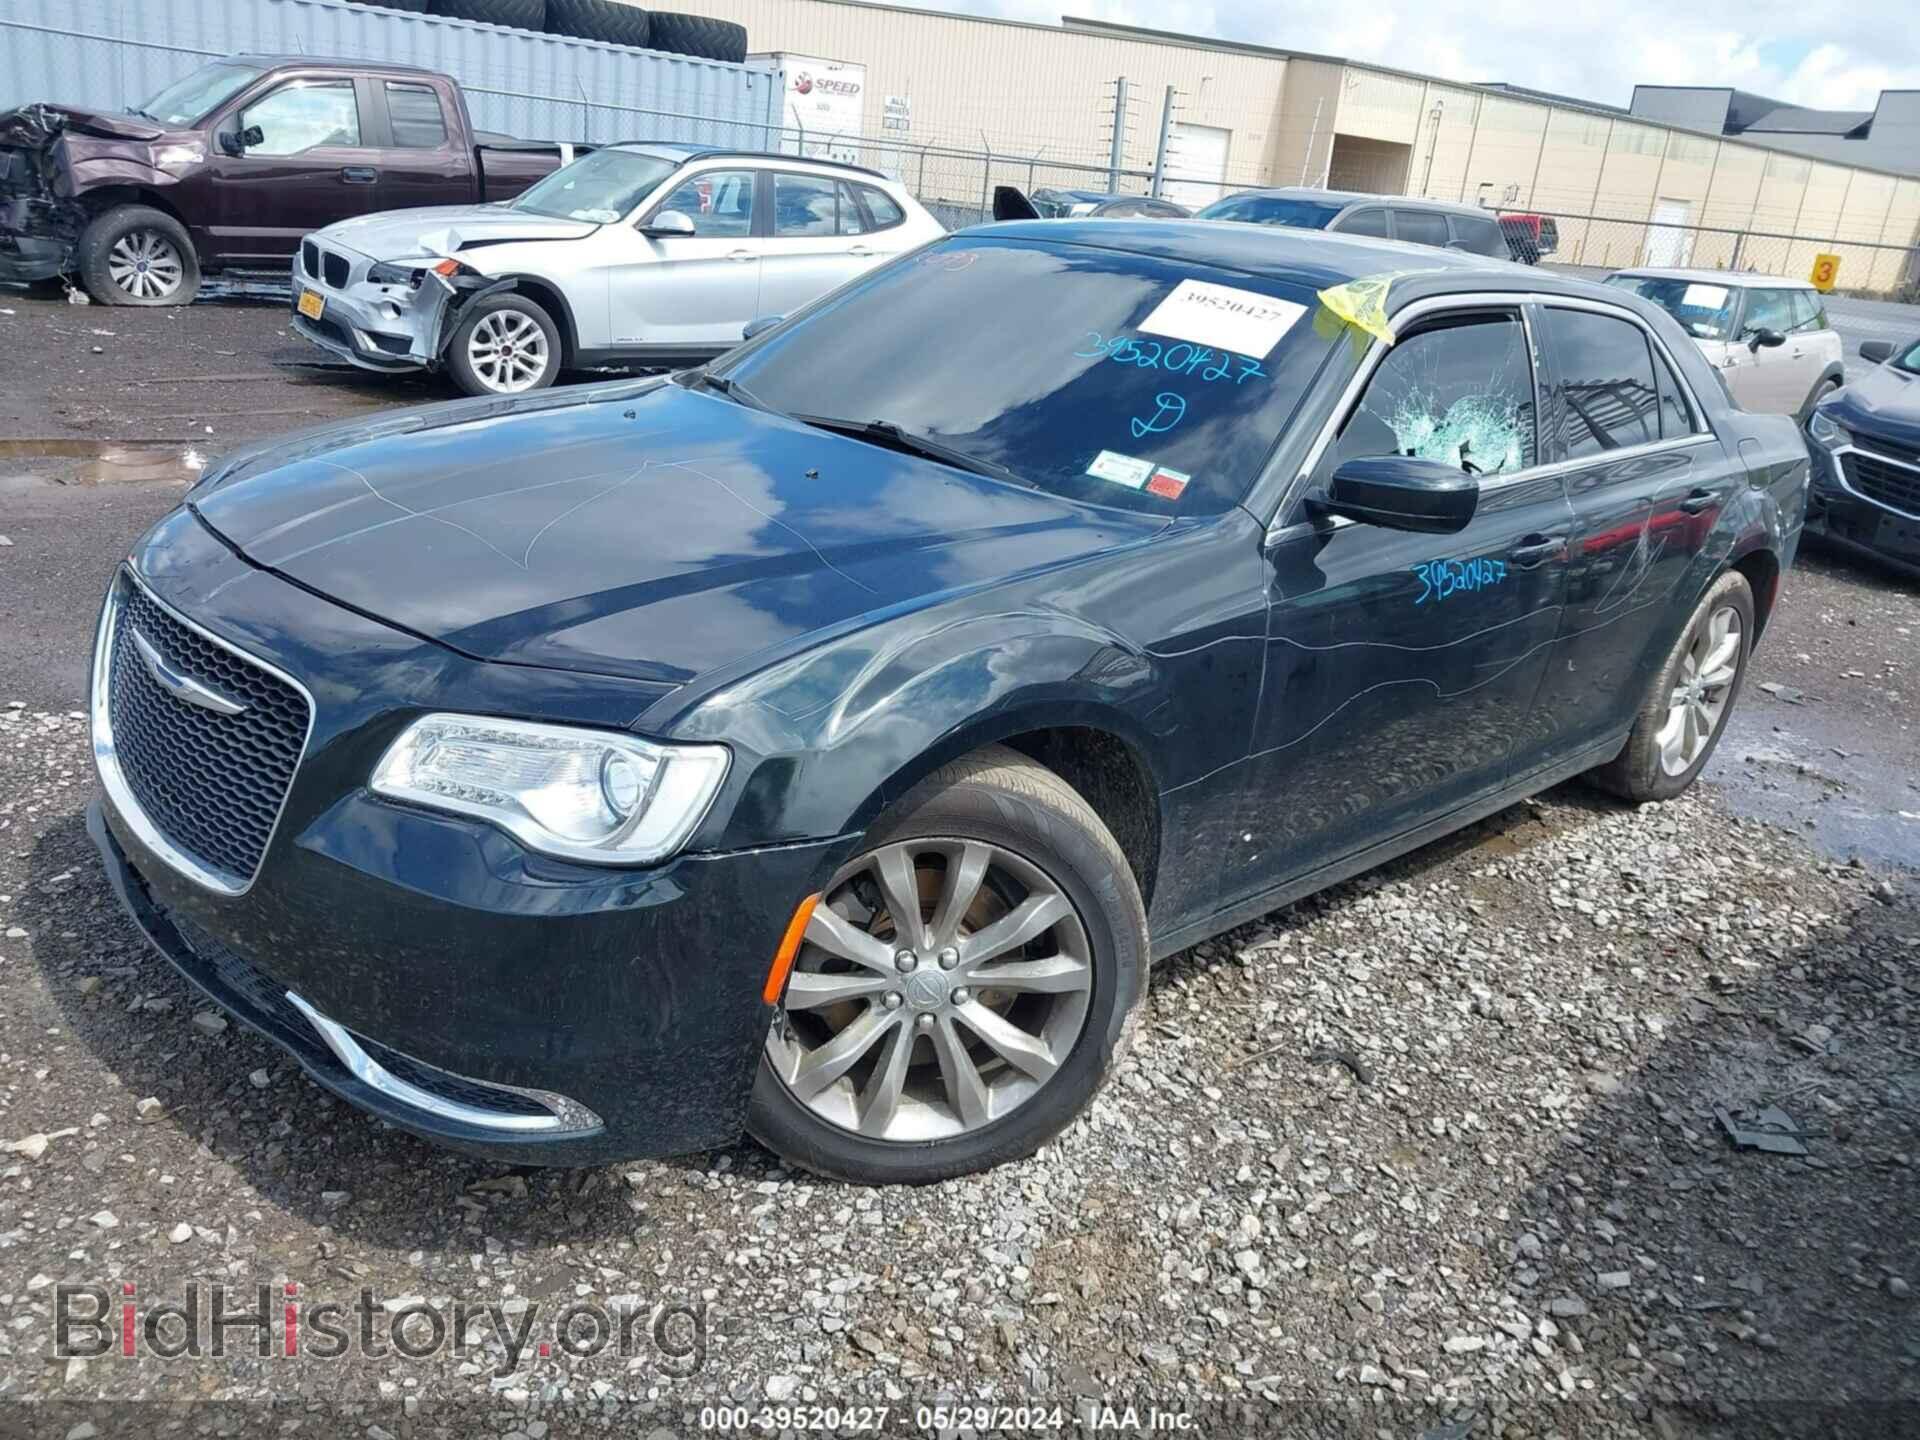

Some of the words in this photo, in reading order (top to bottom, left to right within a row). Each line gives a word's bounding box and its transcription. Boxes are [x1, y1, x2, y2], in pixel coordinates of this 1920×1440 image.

[815, 78, 861, 94] SPEED
[1817, 261, 1833, 283] 3
[1182, 292, 1284, 321] 39520427
[1073, 331, 1268, 385] 39520427
[1410, 558, 1507, 604] 39520427
